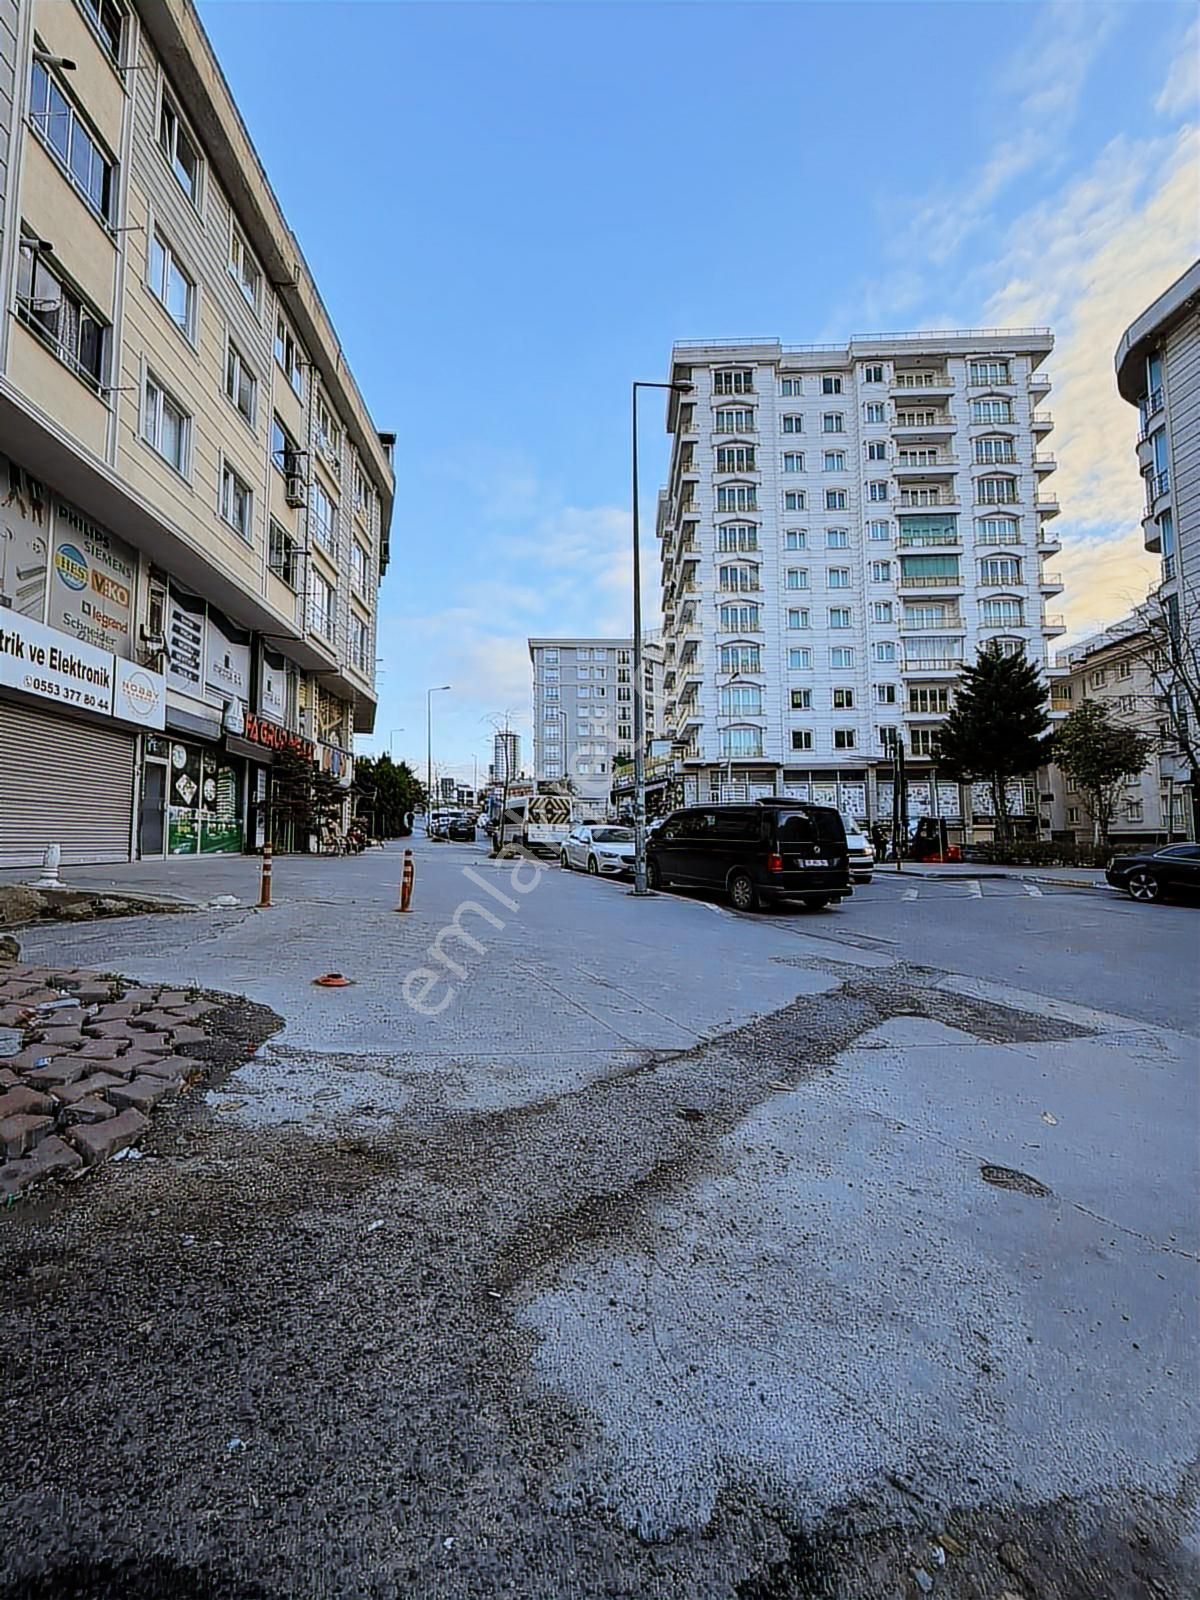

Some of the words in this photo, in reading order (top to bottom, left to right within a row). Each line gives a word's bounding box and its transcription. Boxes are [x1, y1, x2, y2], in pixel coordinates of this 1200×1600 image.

[58, 504, 110, 549] PHILIPS
[61, 556, 86, 580] HES
[83, 540, 131, 579] SIEMENS
[63, 612, 117, 646] Schneider
[29, 644, 45, 666] ve
[49, 646, 110, 689] Elektronik
[33, 678, 60, 696] 0553
[63, 687, 82, 702] 377
[83, 694, 96, 707] 80
[98, 698, 109, 710] 44
